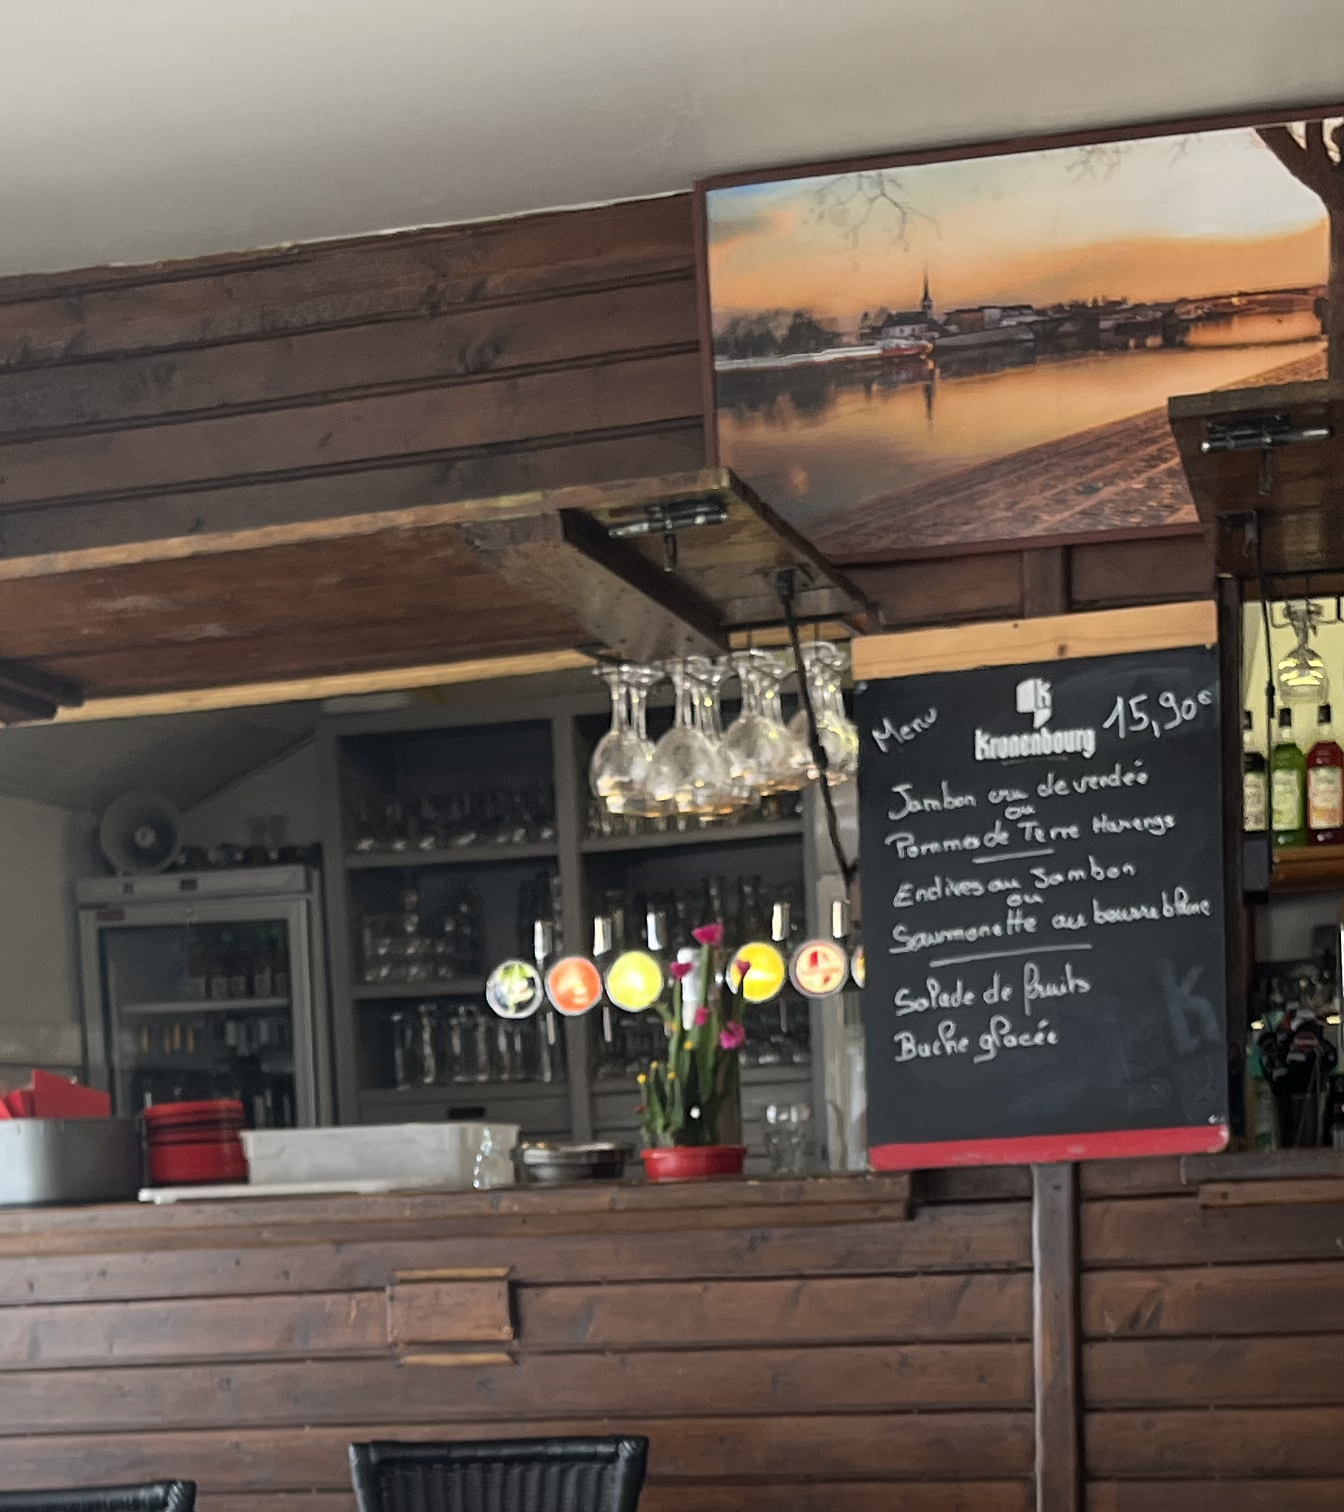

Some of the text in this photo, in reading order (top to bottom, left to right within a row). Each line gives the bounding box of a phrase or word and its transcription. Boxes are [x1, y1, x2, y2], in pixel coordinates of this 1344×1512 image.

[871, 707, 937, 752] Menu
[974, 727, 1096, 760] Kronenbourg
[888, 780, 976, 820] Jambon
[1005, 804, 1036, 820] ou
[1006, 893, 1044, 907] ou
[1052, 912, 1088, 930] au
[894, 961, 1091, 1017] Salade de fruits
